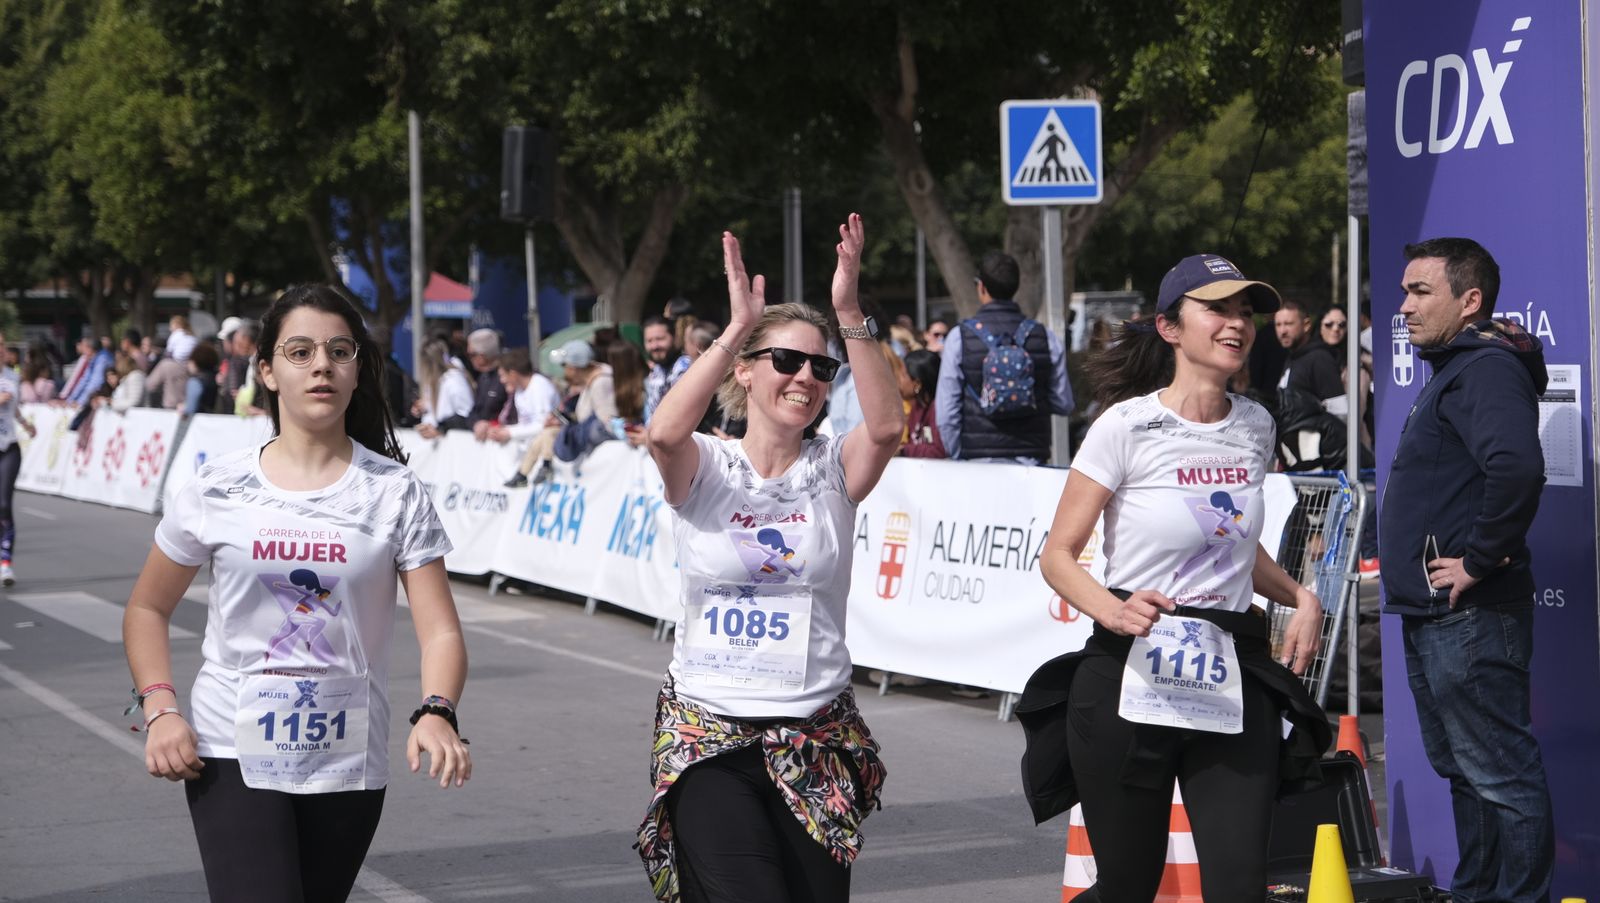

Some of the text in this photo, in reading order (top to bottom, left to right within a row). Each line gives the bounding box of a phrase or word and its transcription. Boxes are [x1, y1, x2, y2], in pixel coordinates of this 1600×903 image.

[1395, 47, 1516, 158] CDX
[1177, 467, 1250, 485] MUJER
[1180, 456, 1245, 465] CARRERA DE LA
[518, 482, 585, 545] NEXA
[606, 494, 663, 562] NEXA
[259, 528, 341, 540] CARRERA DE LA
[930, 517, 1049, 572] ALMERÍA
[252, 540, 347, 563] MUJER
[924, 571, 985, 603] CIUDAD
[1533, 588, 1566, 607] .es
[704, 606, 790, 640] 1085
[1146, 647, 1227, 684] 1115
[258, 691, 289, 699] MUJER
[257, 710, 346, 742] 1151
[275, 742, 331, 751] YOLANDA M
